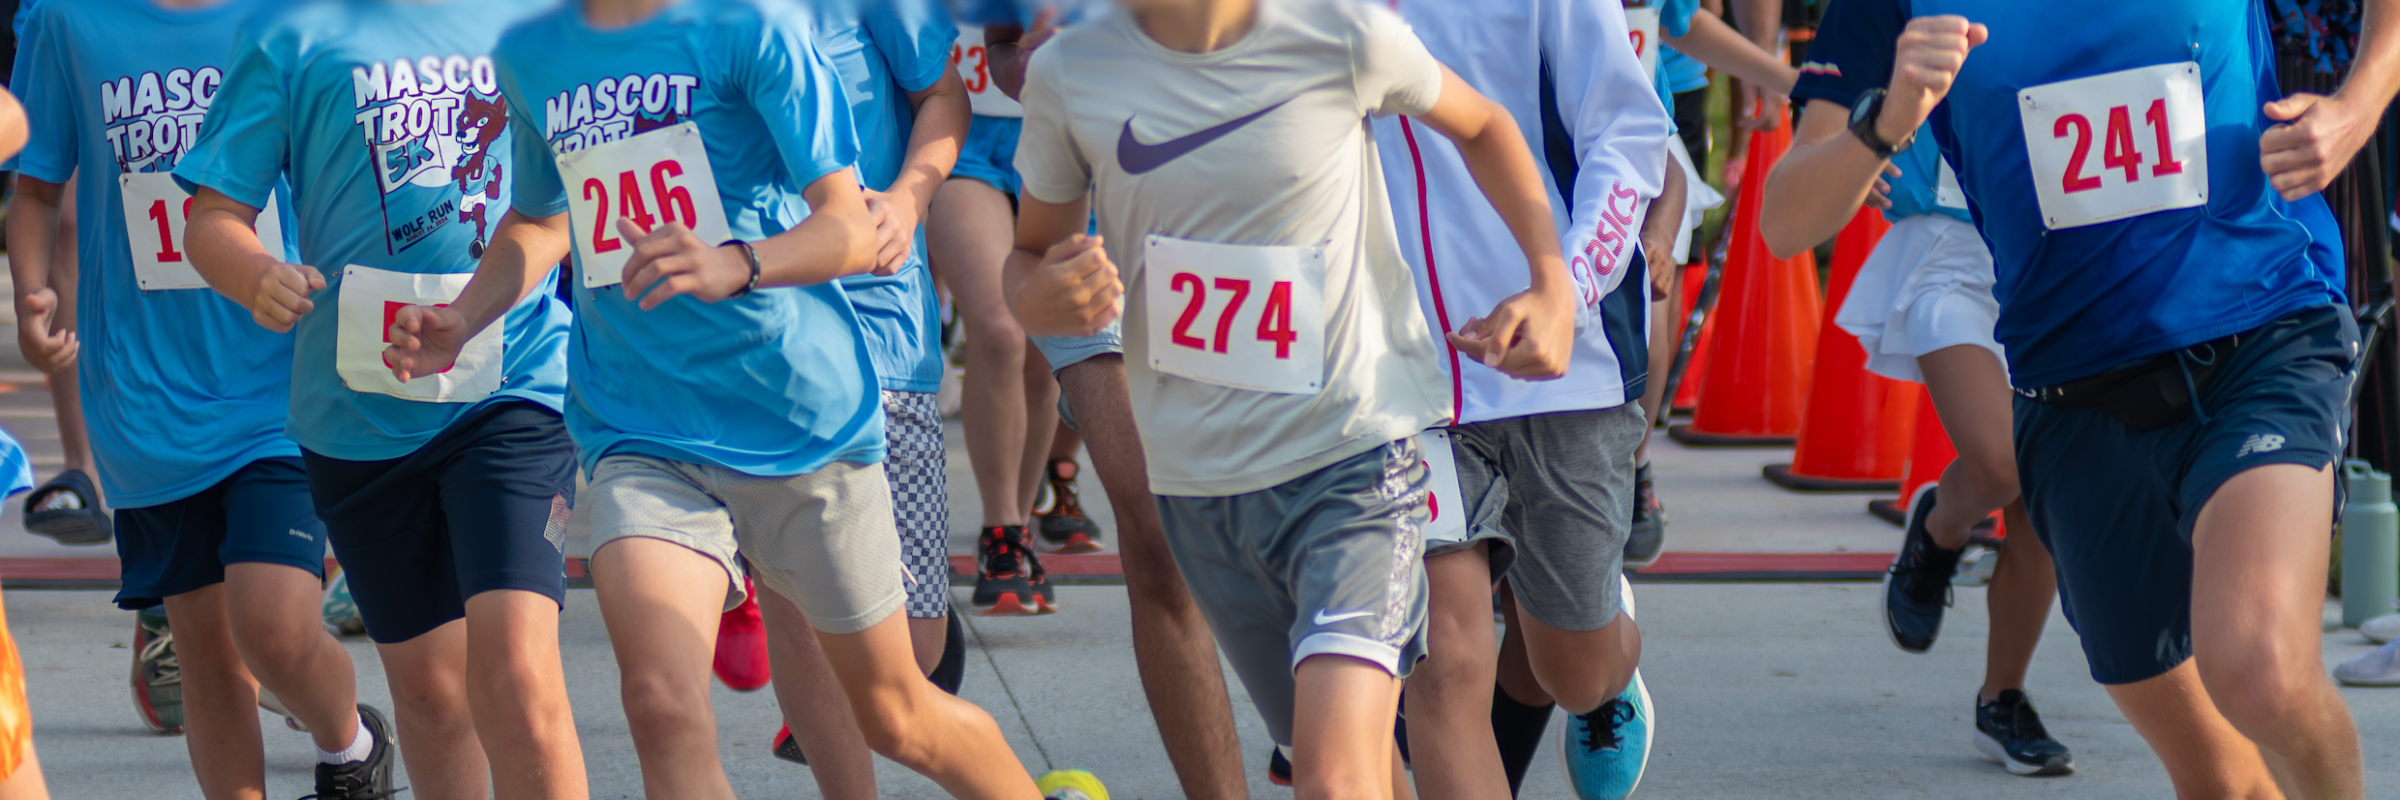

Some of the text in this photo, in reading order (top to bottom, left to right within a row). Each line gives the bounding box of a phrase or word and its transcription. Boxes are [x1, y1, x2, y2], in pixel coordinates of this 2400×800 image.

[100, 66, 223, 125] MASC
[352, 54, 501, 110] MASCO
[545, 72, 700, 142] MASCOT
[105, 112, 204, 164] TROT
[355, 97, 459, 146] TROT
[2053, 98, 2183, 195] 241
[386, 134, 434, 183] 5K
[391, 199, 454, 242] WOLF RUN
[406, 228, 425, 243] AUGUST
[583, 160, 697, 254] 246
[1585, 179, 1638, 277] asics
[1170, 272, 1297, 359] 274
